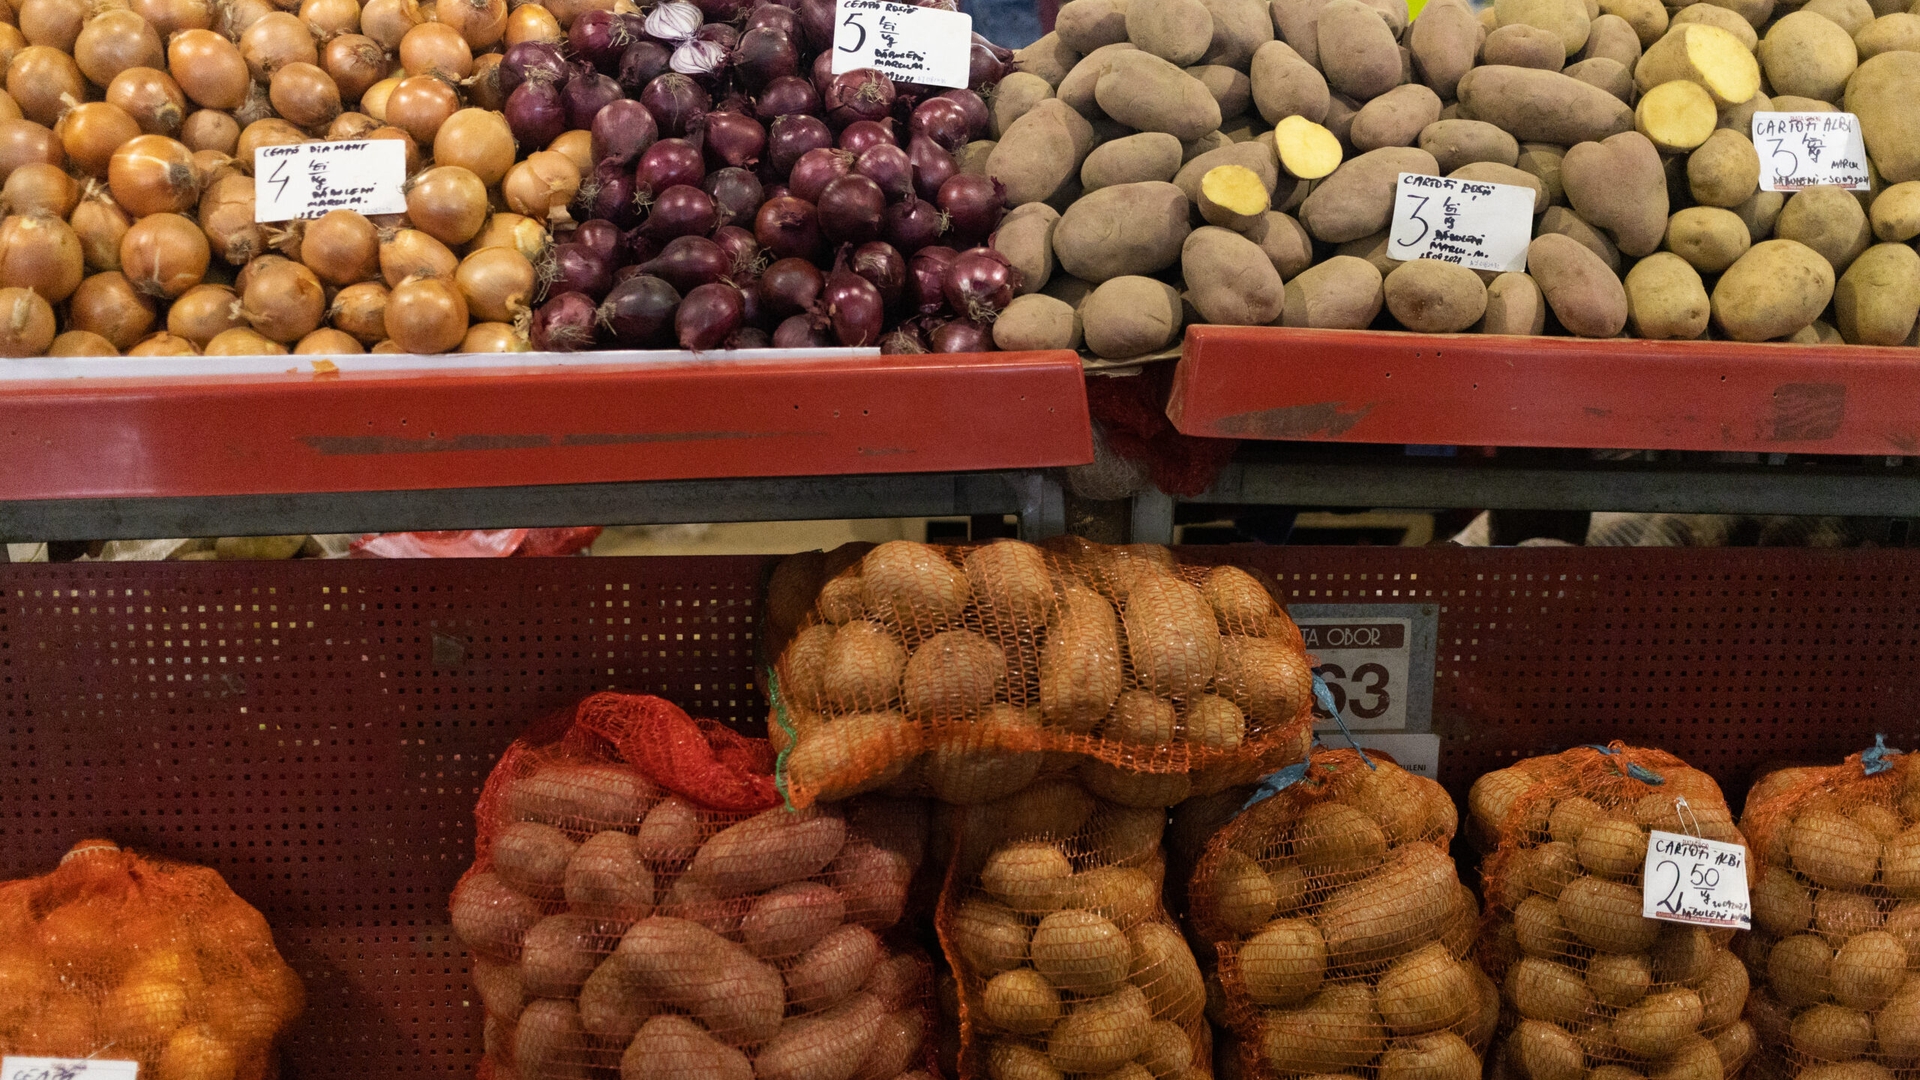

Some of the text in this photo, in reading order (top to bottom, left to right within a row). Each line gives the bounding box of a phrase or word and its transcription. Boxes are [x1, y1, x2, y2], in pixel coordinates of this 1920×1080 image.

[838, 13, 866, 53] 5
[1757, 118, 1817, 136] CARTOFI
[1766, 138, 1798, 178] 3
[267, 159, 290, 203] 4
[1397, 194, 1430, 247] 3
[1327, 628, 1381, 646] OBOR
[1690, 863, 1720, 887] 50
